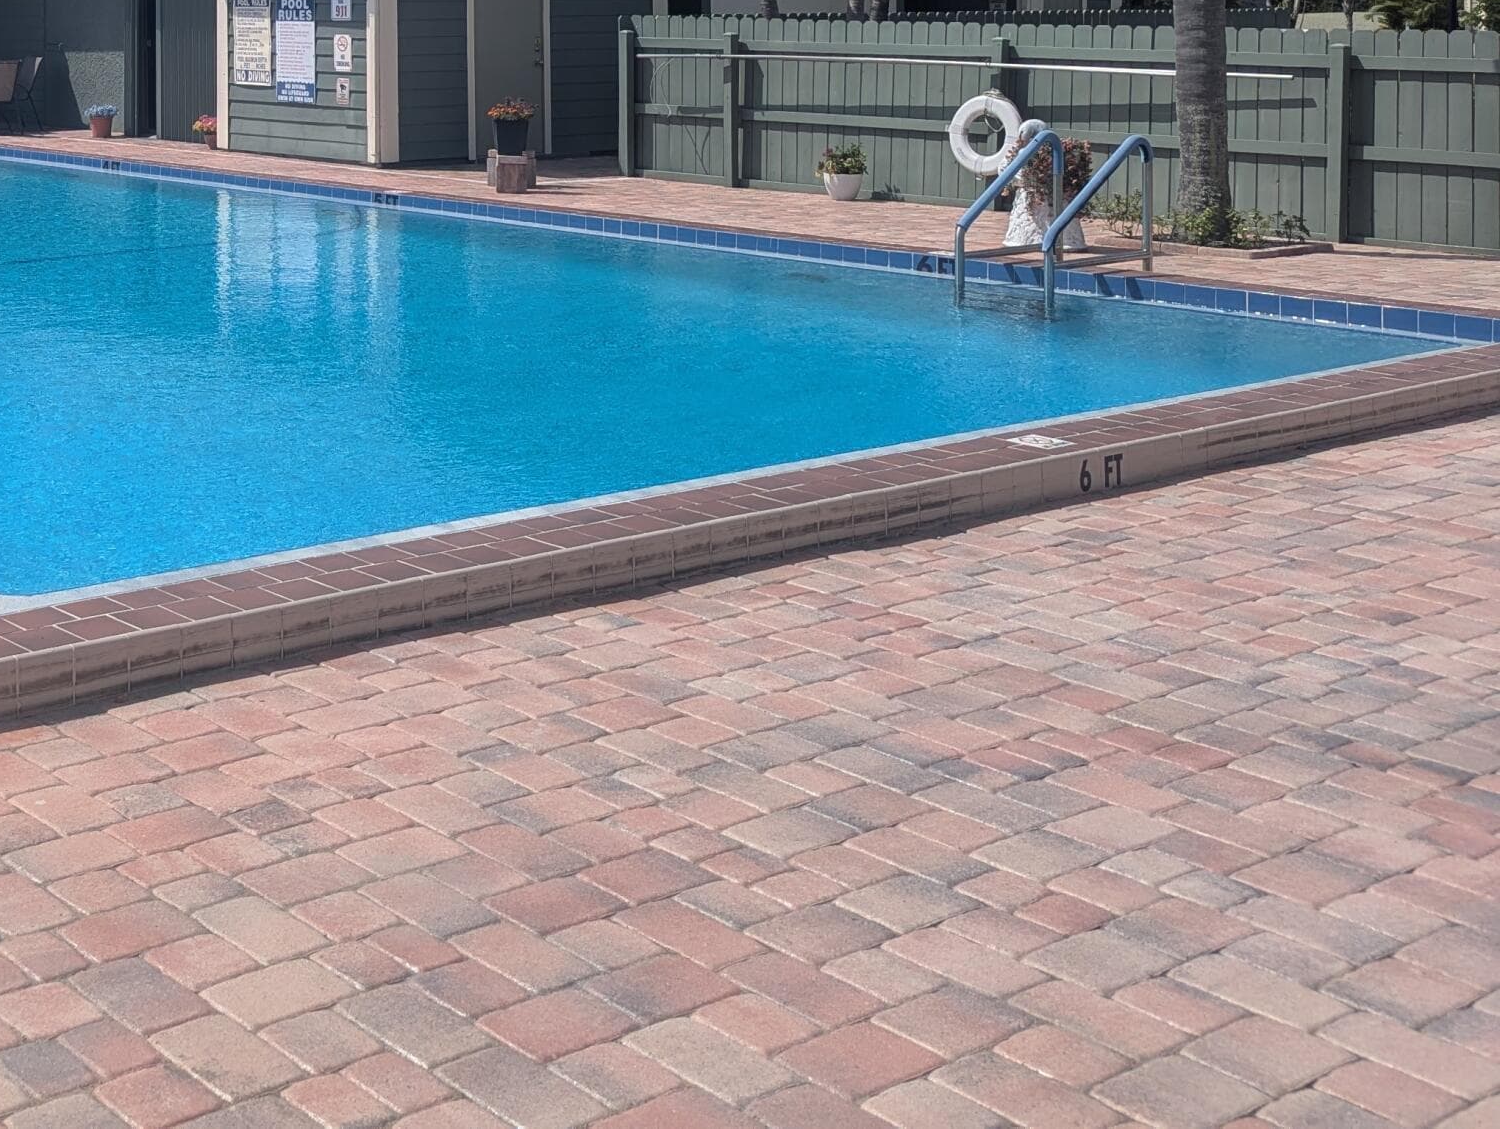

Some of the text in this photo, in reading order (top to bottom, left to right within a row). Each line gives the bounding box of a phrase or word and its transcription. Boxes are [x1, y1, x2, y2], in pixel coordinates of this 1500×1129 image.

[237, 0, 250, 7] POOL
[278, 9, 312, 21] RULES
[335, 5, 348, 17] 911
[236, 70, 270, 83] NO DIVING
[102, 160, 109, 169] 4
[374, 192, 399, 205] 5 FT
[916, 255, 933, 273] 6
[1079, 453, 1124, 492] 6 FT
